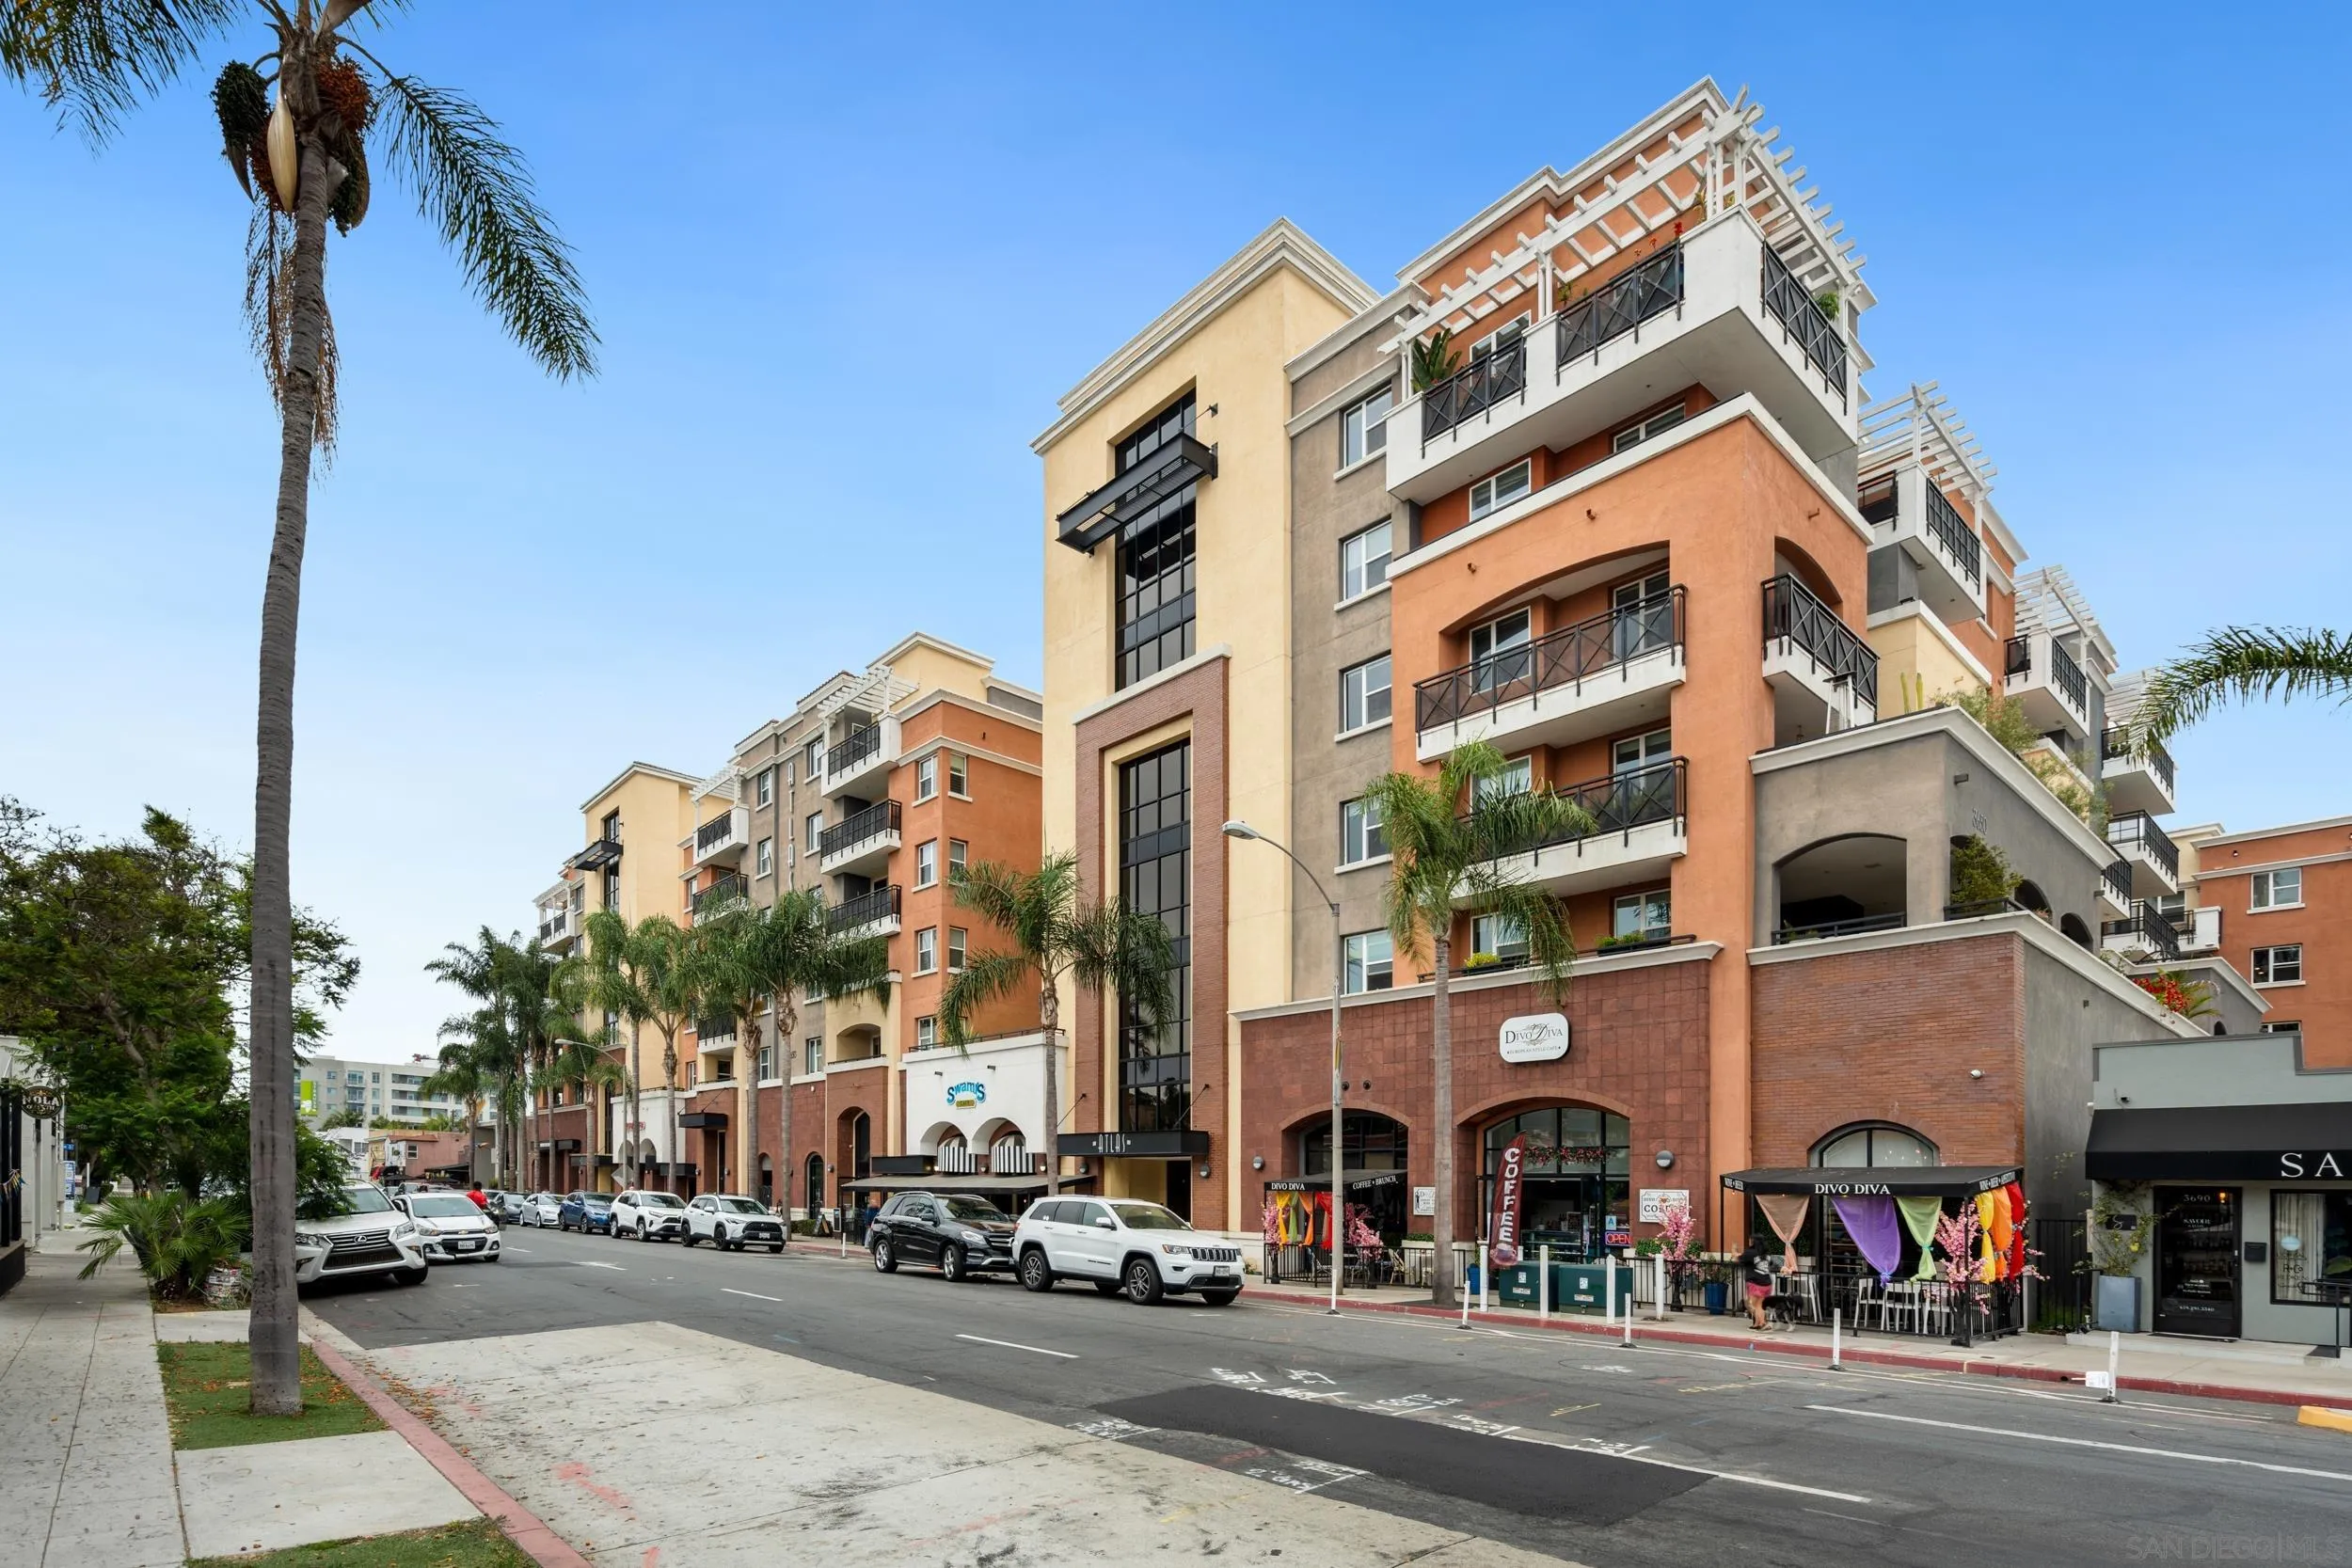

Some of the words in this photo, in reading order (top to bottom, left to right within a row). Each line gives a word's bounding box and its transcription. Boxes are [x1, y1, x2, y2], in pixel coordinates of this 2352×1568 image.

[1098, 1133, 1125, 1153] ATLAS
[1271, 1182, 1287, 1191] DIVO
[1288, 1182, 1305, 1191] DIVA
[1352, 1180, 1373, 1190] COFFEE
[1375, 1175, 1397, 1185] BRUNCH
[1815, 1183, 1850, 1195] DIVO
[1854, 1183, 1891, 1195] DIVA
[1499, 1147, 1520, 1243] COFFEE
[1607, 1233, 1632, 1244] OPEN
